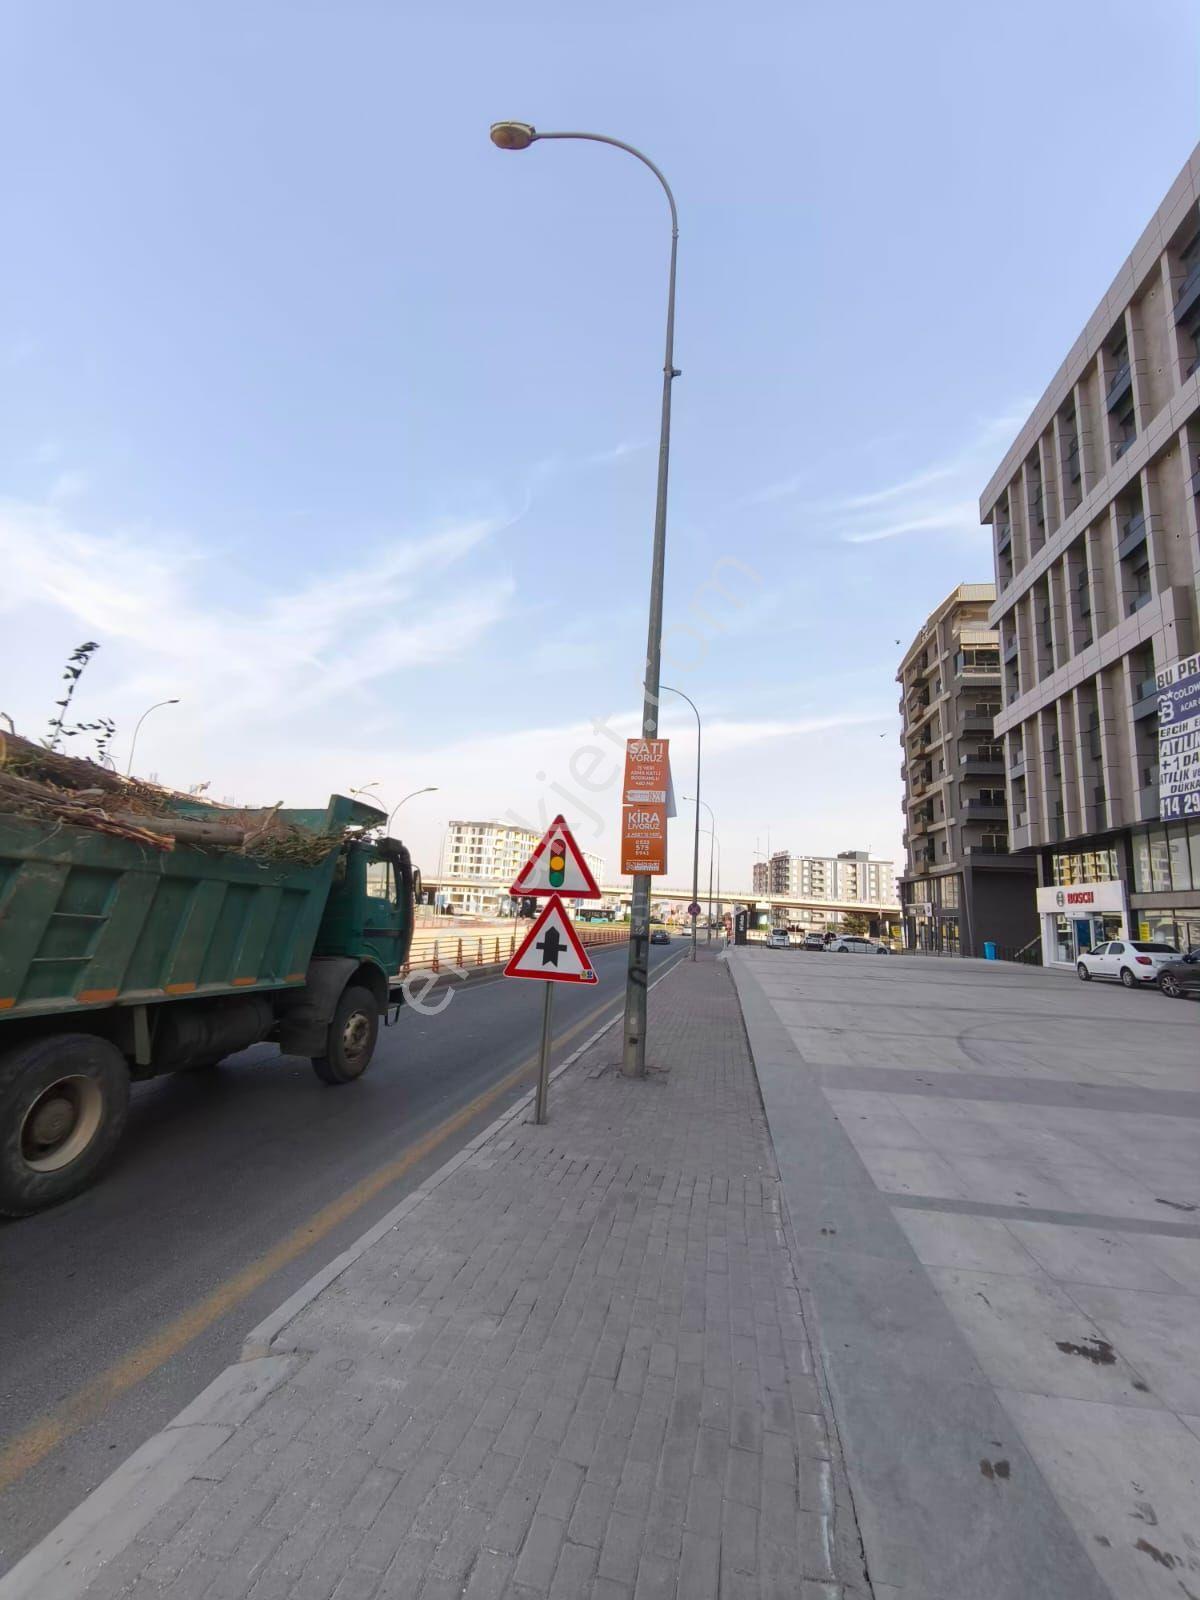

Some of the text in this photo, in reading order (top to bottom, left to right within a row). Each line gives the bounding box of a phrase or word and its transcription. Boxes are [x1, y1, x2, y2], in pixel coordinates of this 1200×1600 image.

[1157, 669, 1173, 688] BU
[629, 742, 664, 754] SATI
[630, 754, 664, 763] YORUZ
[628, 809, 660, 824] KİRA
[1067, 891, 1094, 904] BOSCH
